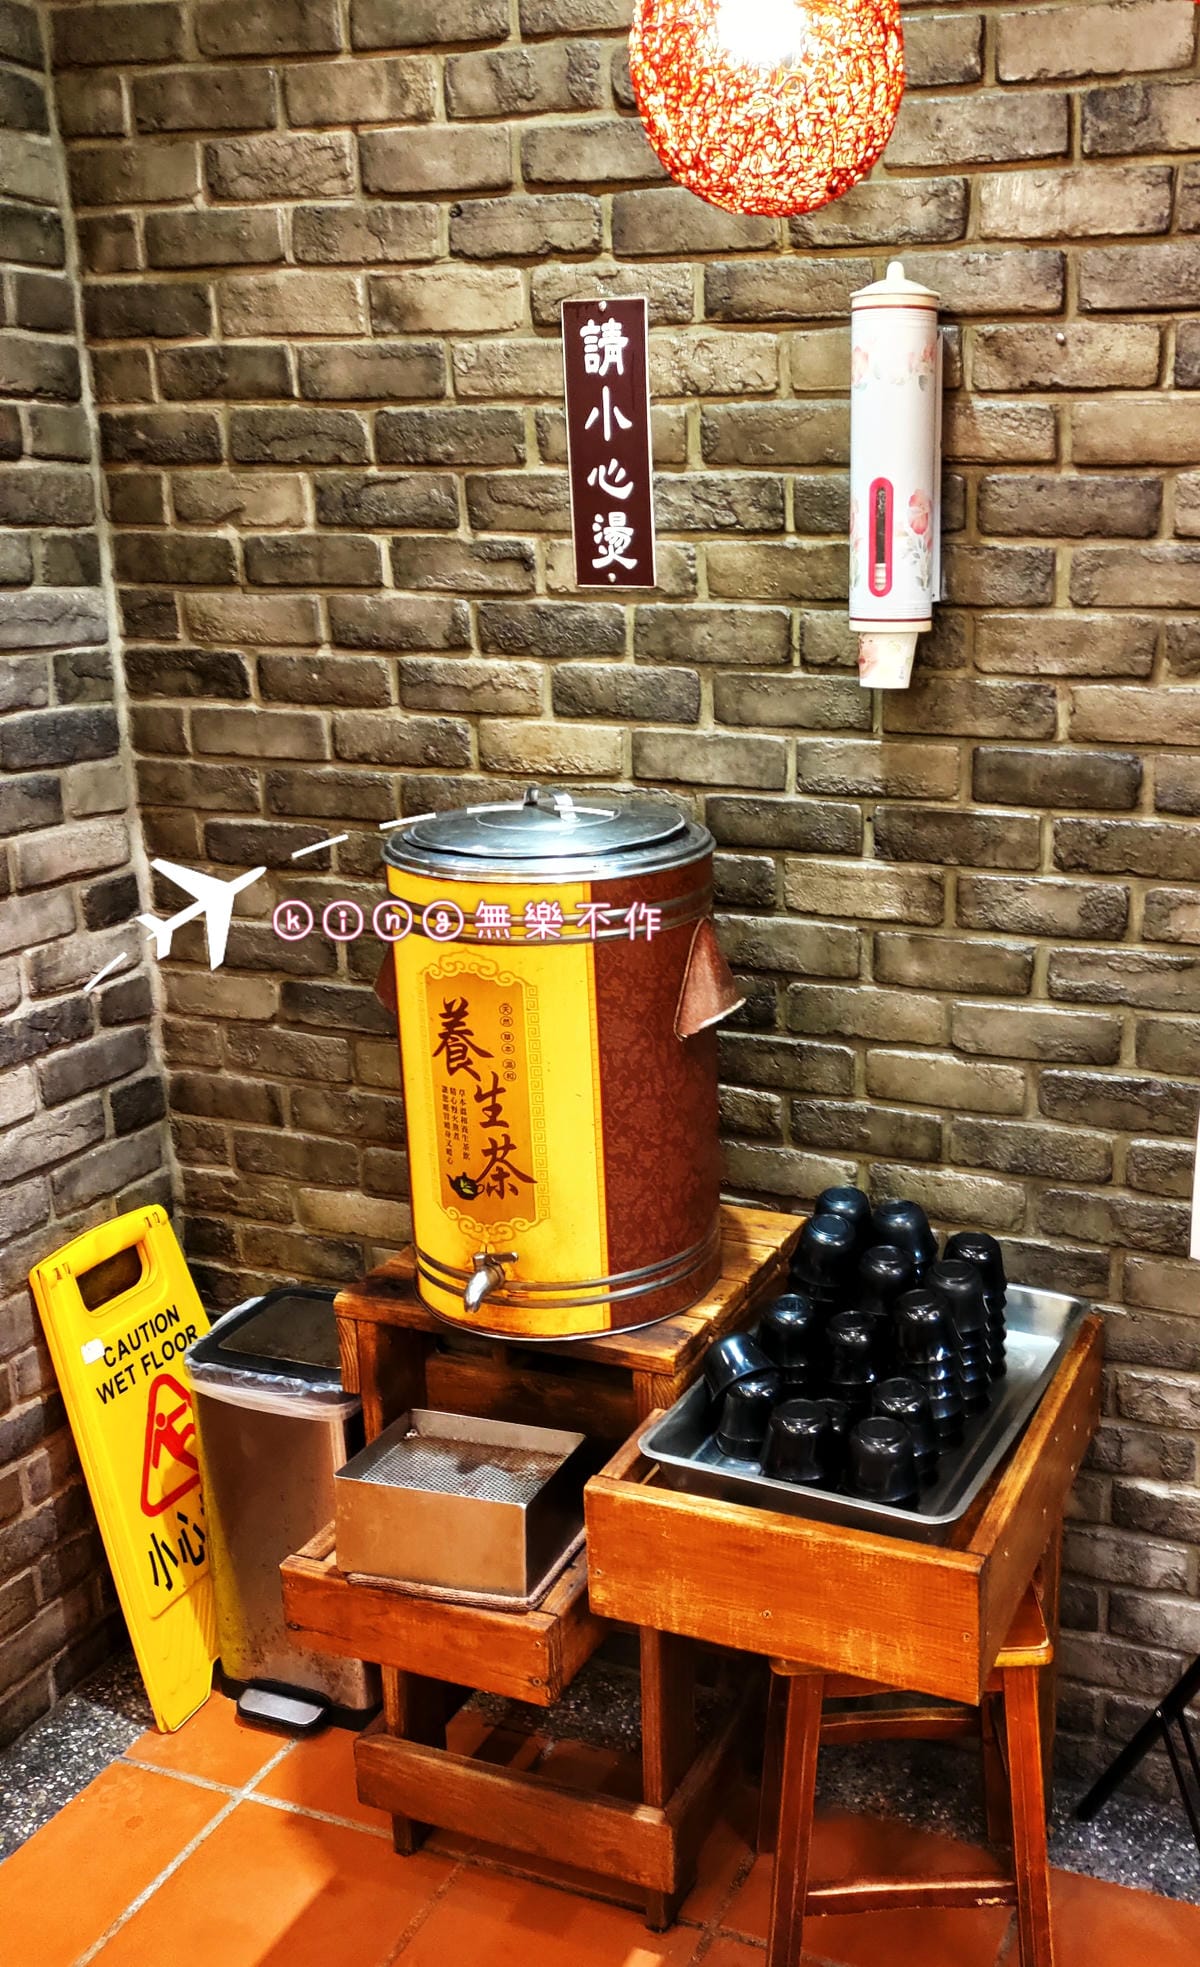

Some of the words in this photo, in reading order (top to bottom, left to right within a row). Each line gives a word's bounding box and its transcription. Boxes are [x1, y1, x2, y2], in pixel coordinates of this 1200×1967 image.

[580, 317, 638, 571] 請小心燙
[432, 996, 538, 1200] 養生茶
[96, 1364, 136, 1404] WET
[140, 1324, 198, 1376] FLOOR
[103, 1304, 180, 1367] CAUTION
[148, 1494, 205, 1591] 小心
